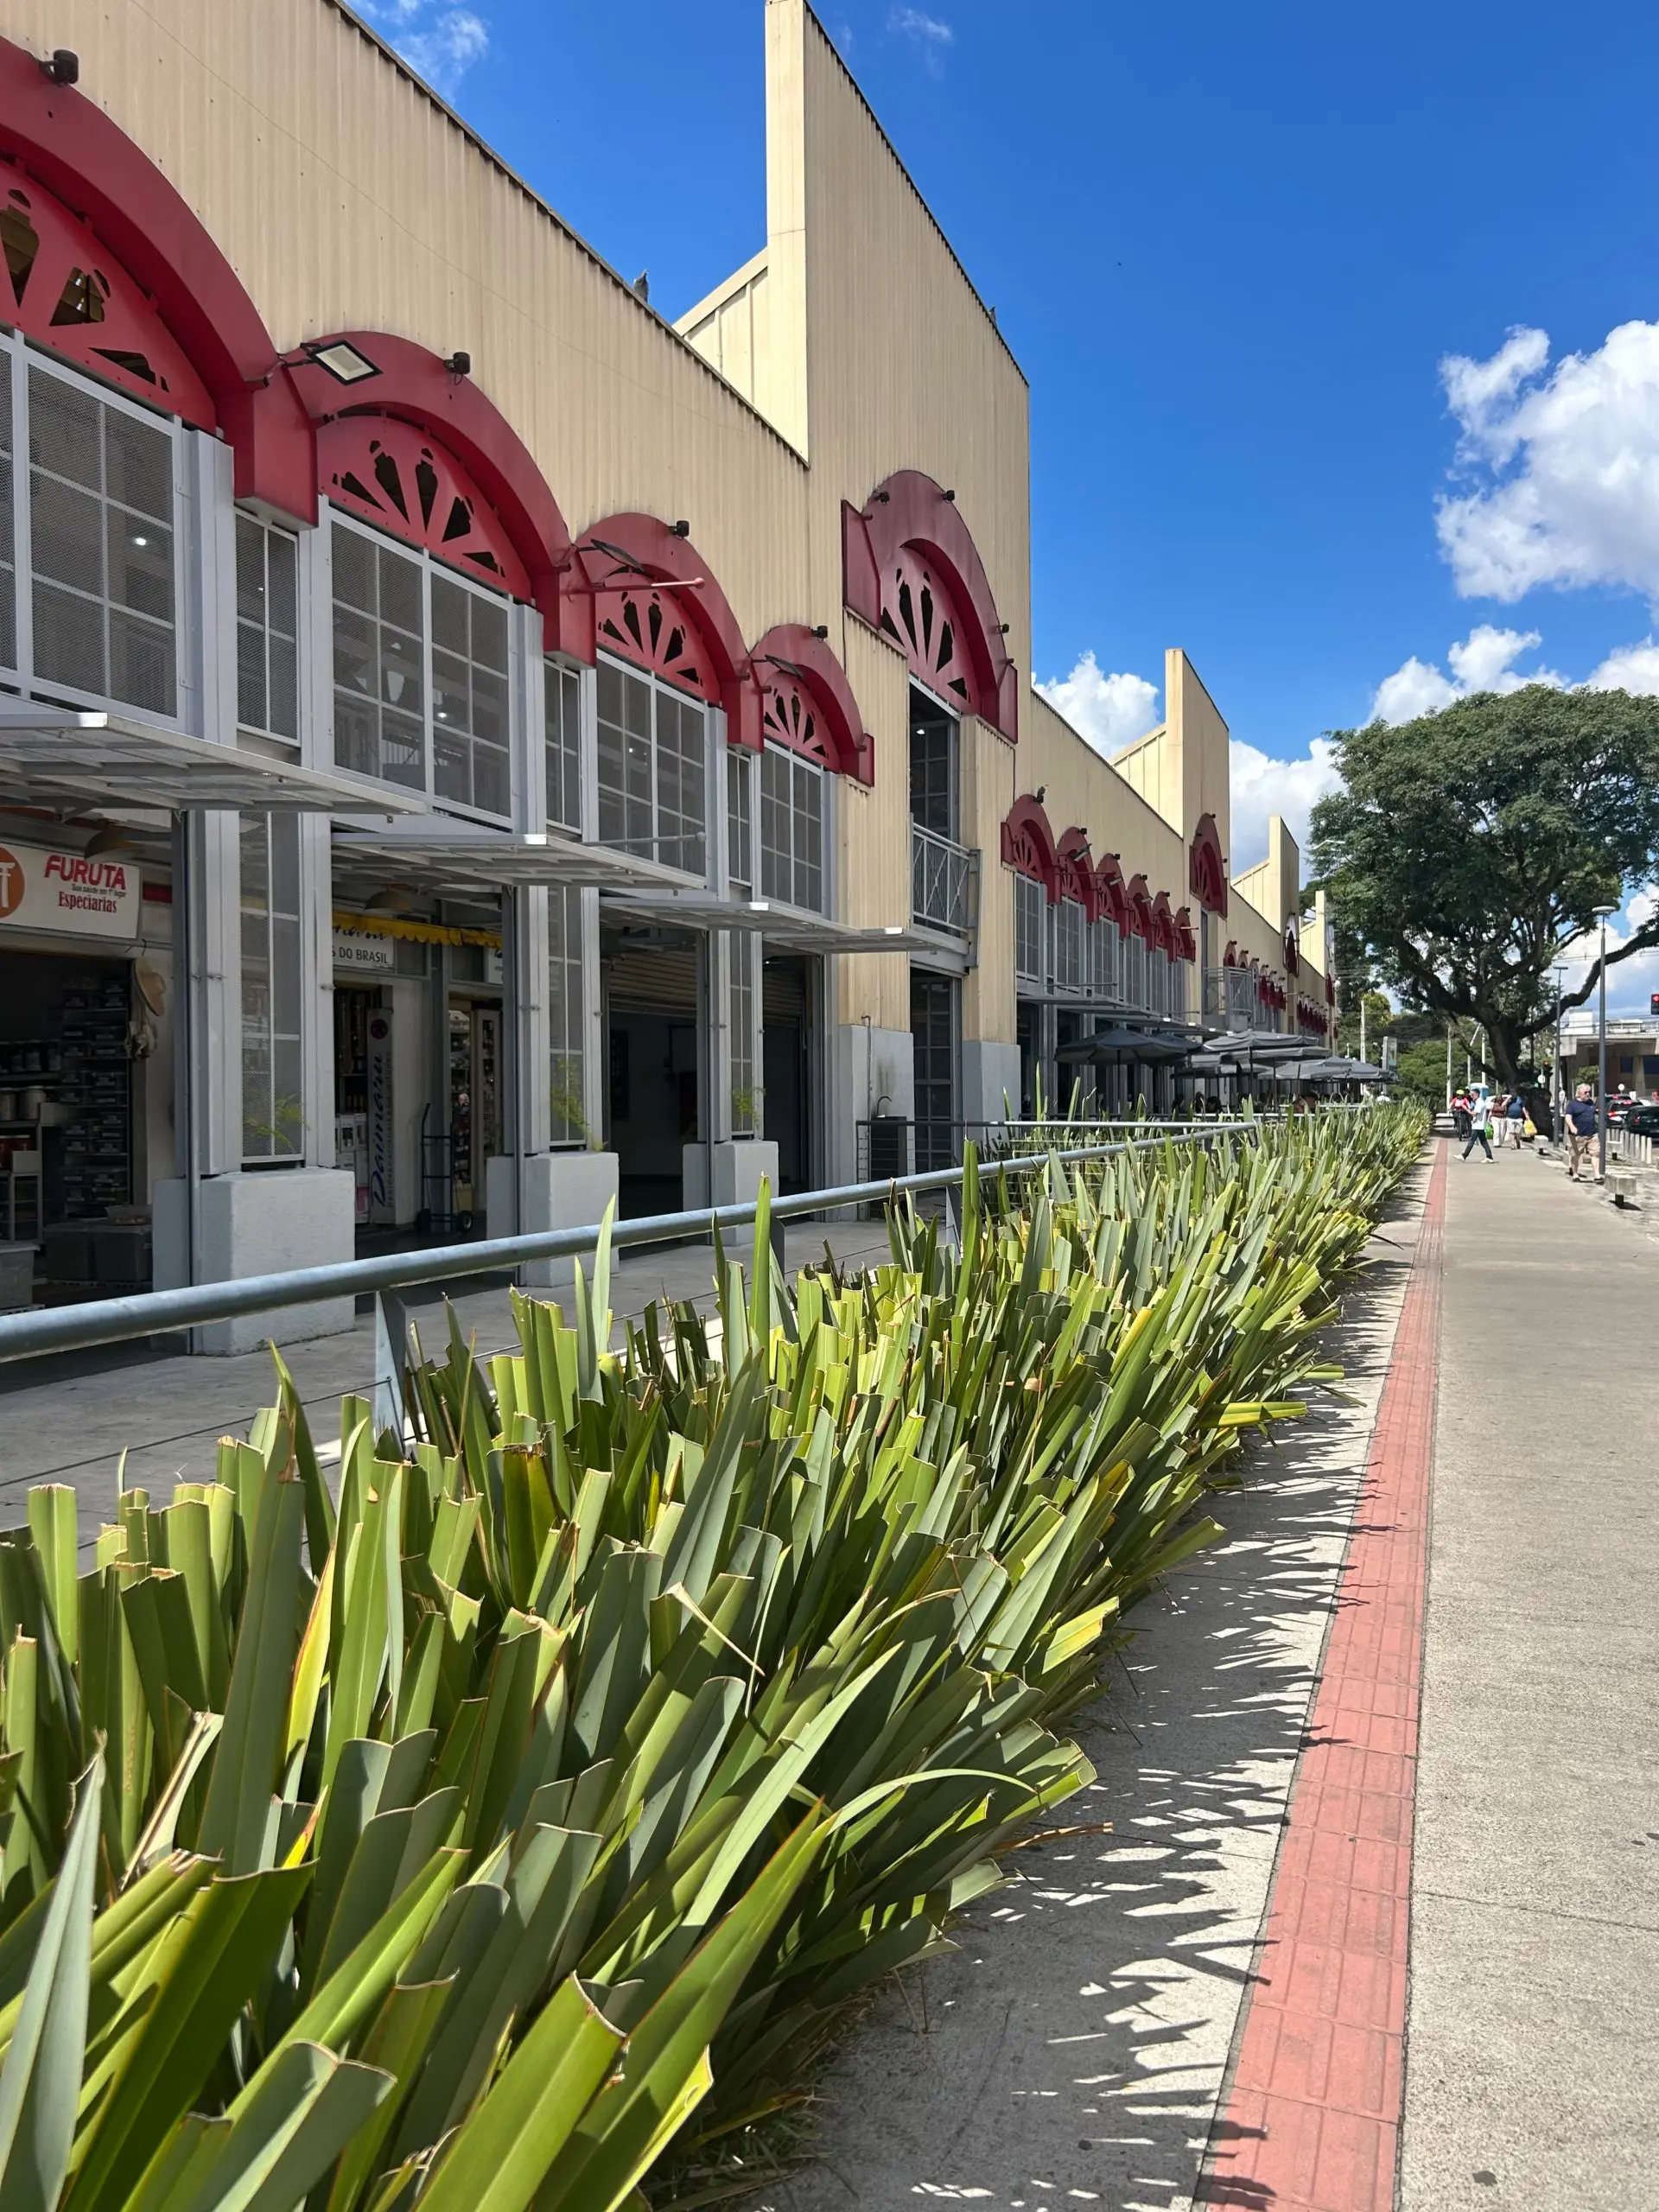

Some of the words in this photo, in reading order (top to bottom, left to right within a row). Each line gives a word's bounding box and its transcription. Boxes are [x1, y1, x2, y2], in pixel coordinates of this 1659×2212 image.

[44, 855, 126, 891] FURUTA
[58, 891, 118, 913] Especiarias
[339, 946, 353, 959] DO
[356, 949, 389, 963] BRASIL
[371, 1053, 385, 1207] Daimaru
